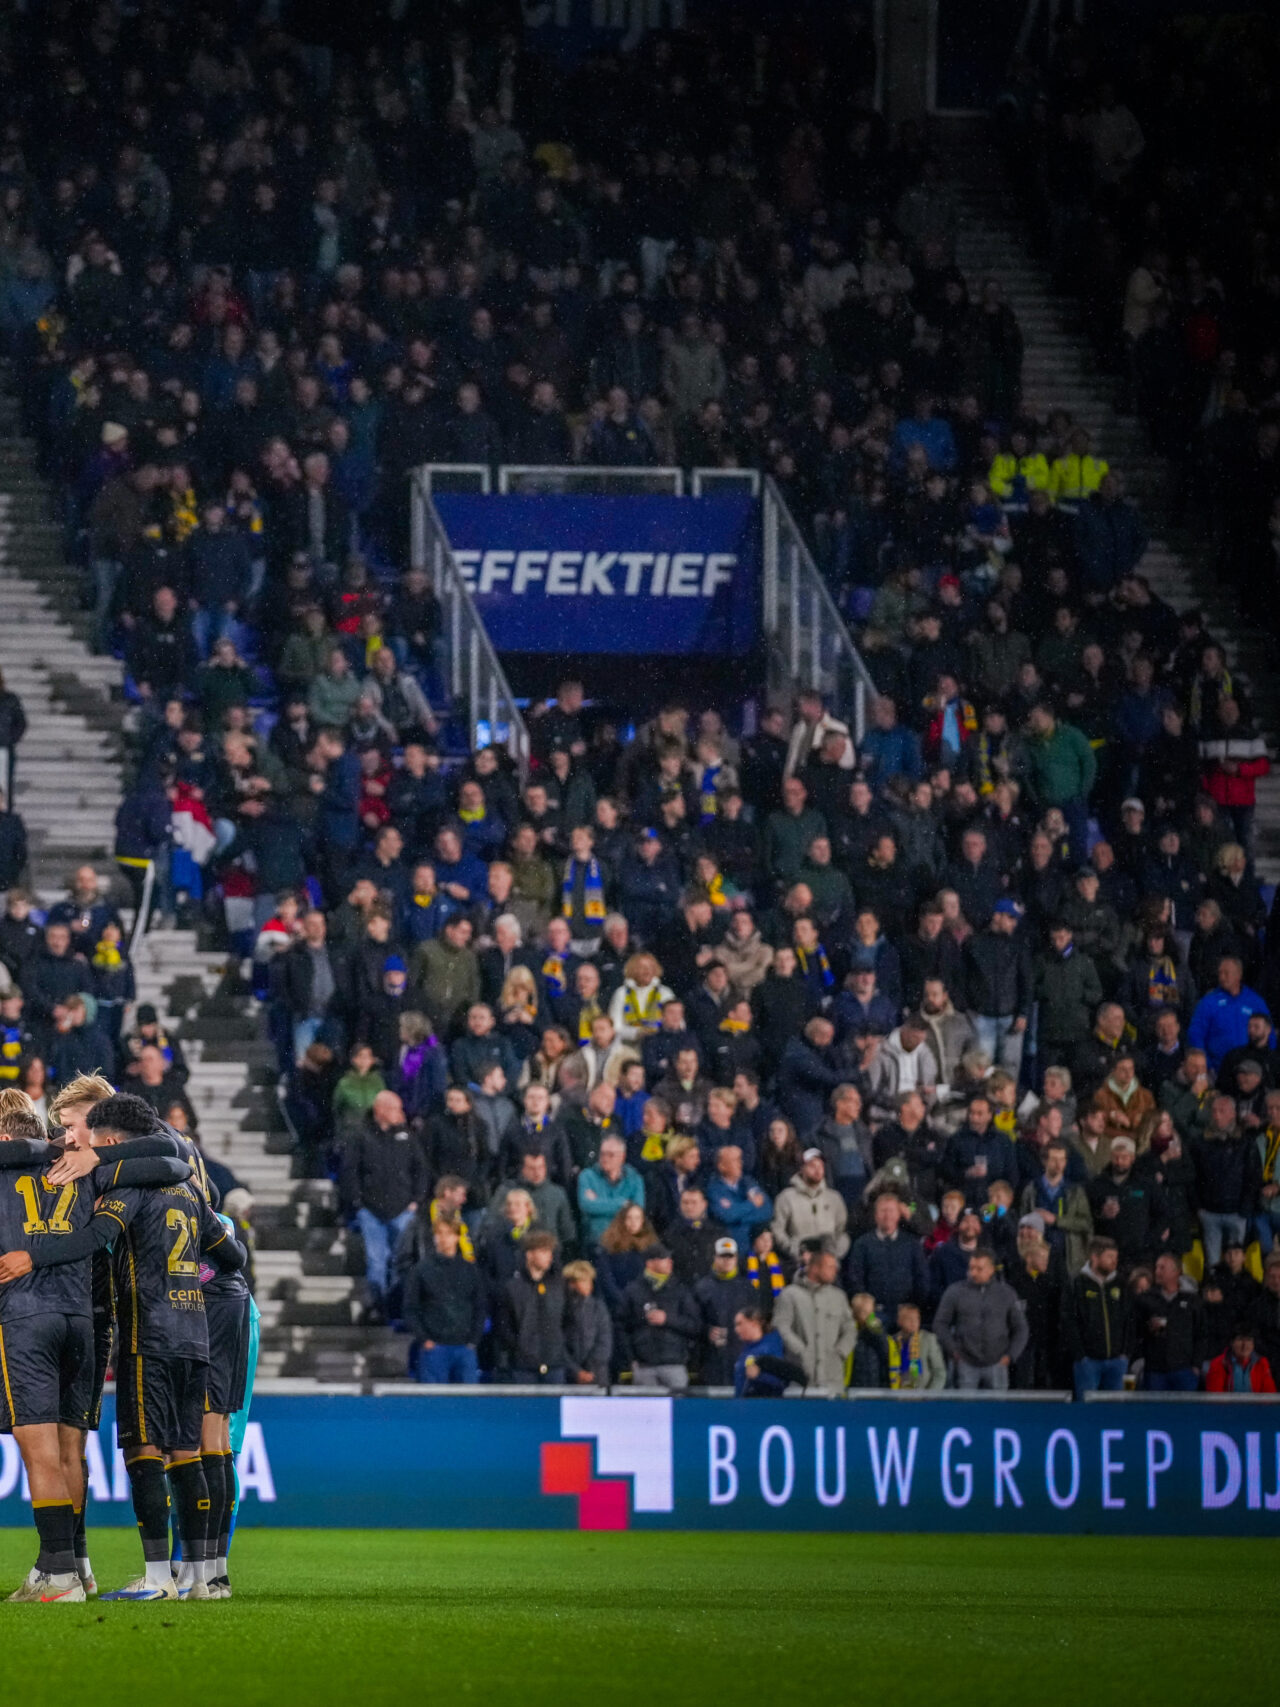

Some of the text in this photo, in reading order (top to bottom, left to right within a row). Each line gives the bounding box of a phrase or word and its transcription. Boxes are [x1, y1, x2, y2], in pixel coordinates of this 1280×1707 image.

[446, 550, 737, 597] EFFEKTIEF
[15, 1175, 79, 1235] 17
[166, 1208, 199, 1277] 2
[709, 1425, 1175, 1510] BOUWGROEP
